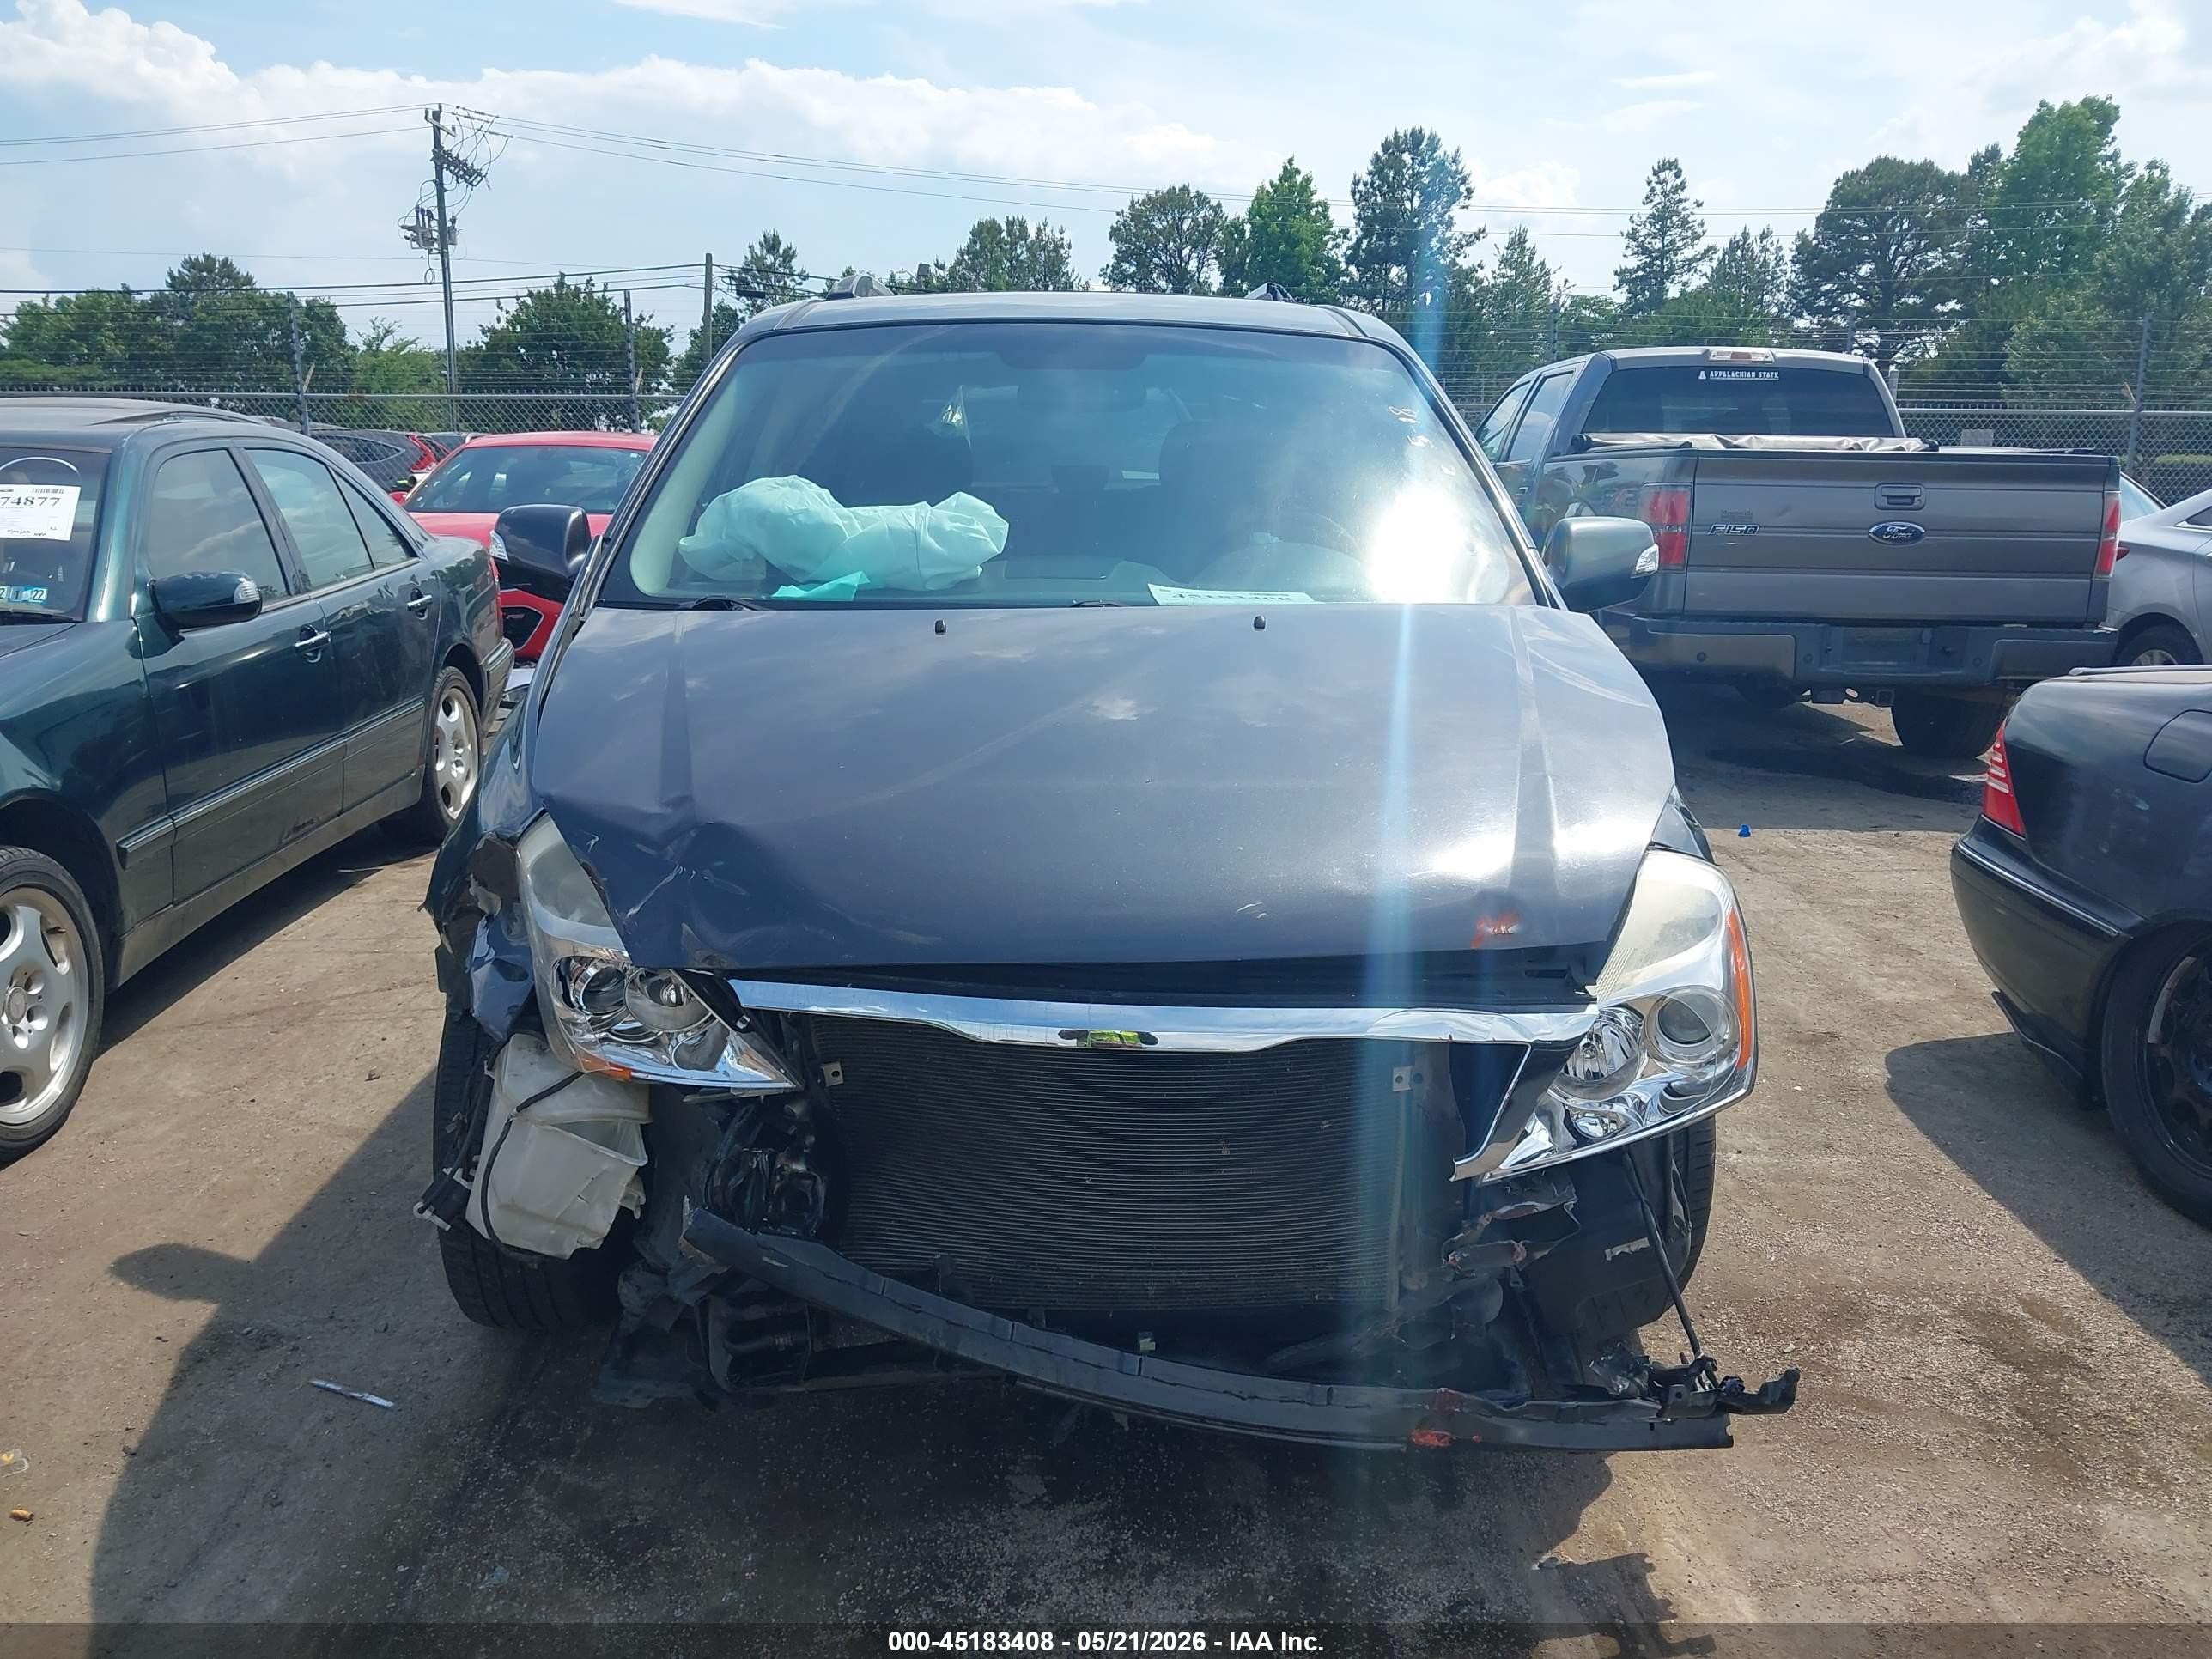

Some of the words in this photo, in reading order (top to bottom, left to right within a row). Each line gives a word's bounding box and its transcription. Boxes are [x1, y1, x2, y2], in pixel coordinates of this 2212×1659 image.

[1709, 370, 1756, 379] APPALACHIAN
[1758, 370, 1779, 379] STATE
[1708, 524, 1759, 536] F150
